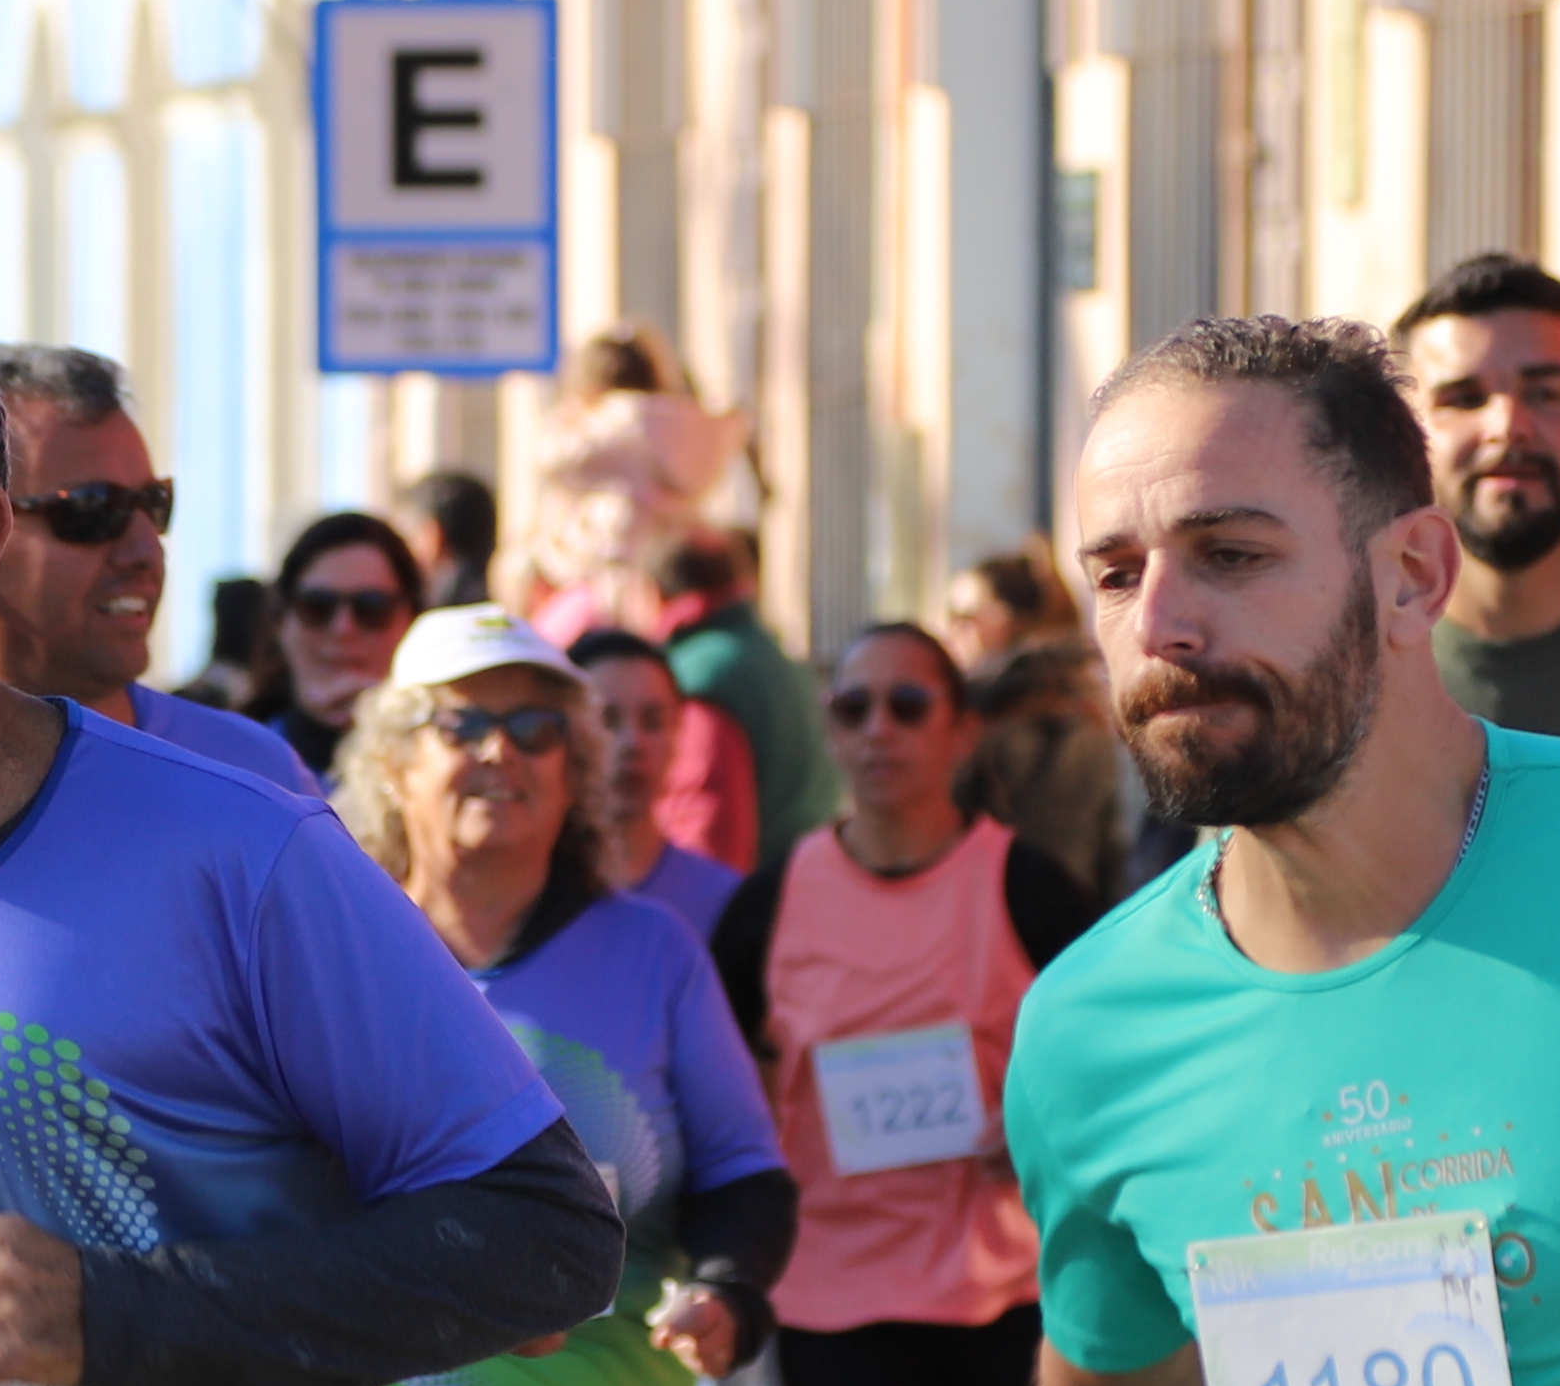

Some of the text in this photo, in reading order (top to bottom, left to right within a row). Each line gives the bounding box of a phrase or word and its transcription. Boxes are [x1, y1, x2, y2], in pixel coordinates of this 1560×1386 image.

[392, 49, 484, 186] E
[850, 1082, 969, 1136] 1222
[1338, 1079, 1391, 1125] 50
[1399, 1146, 1515, 1193] CORRIDA
